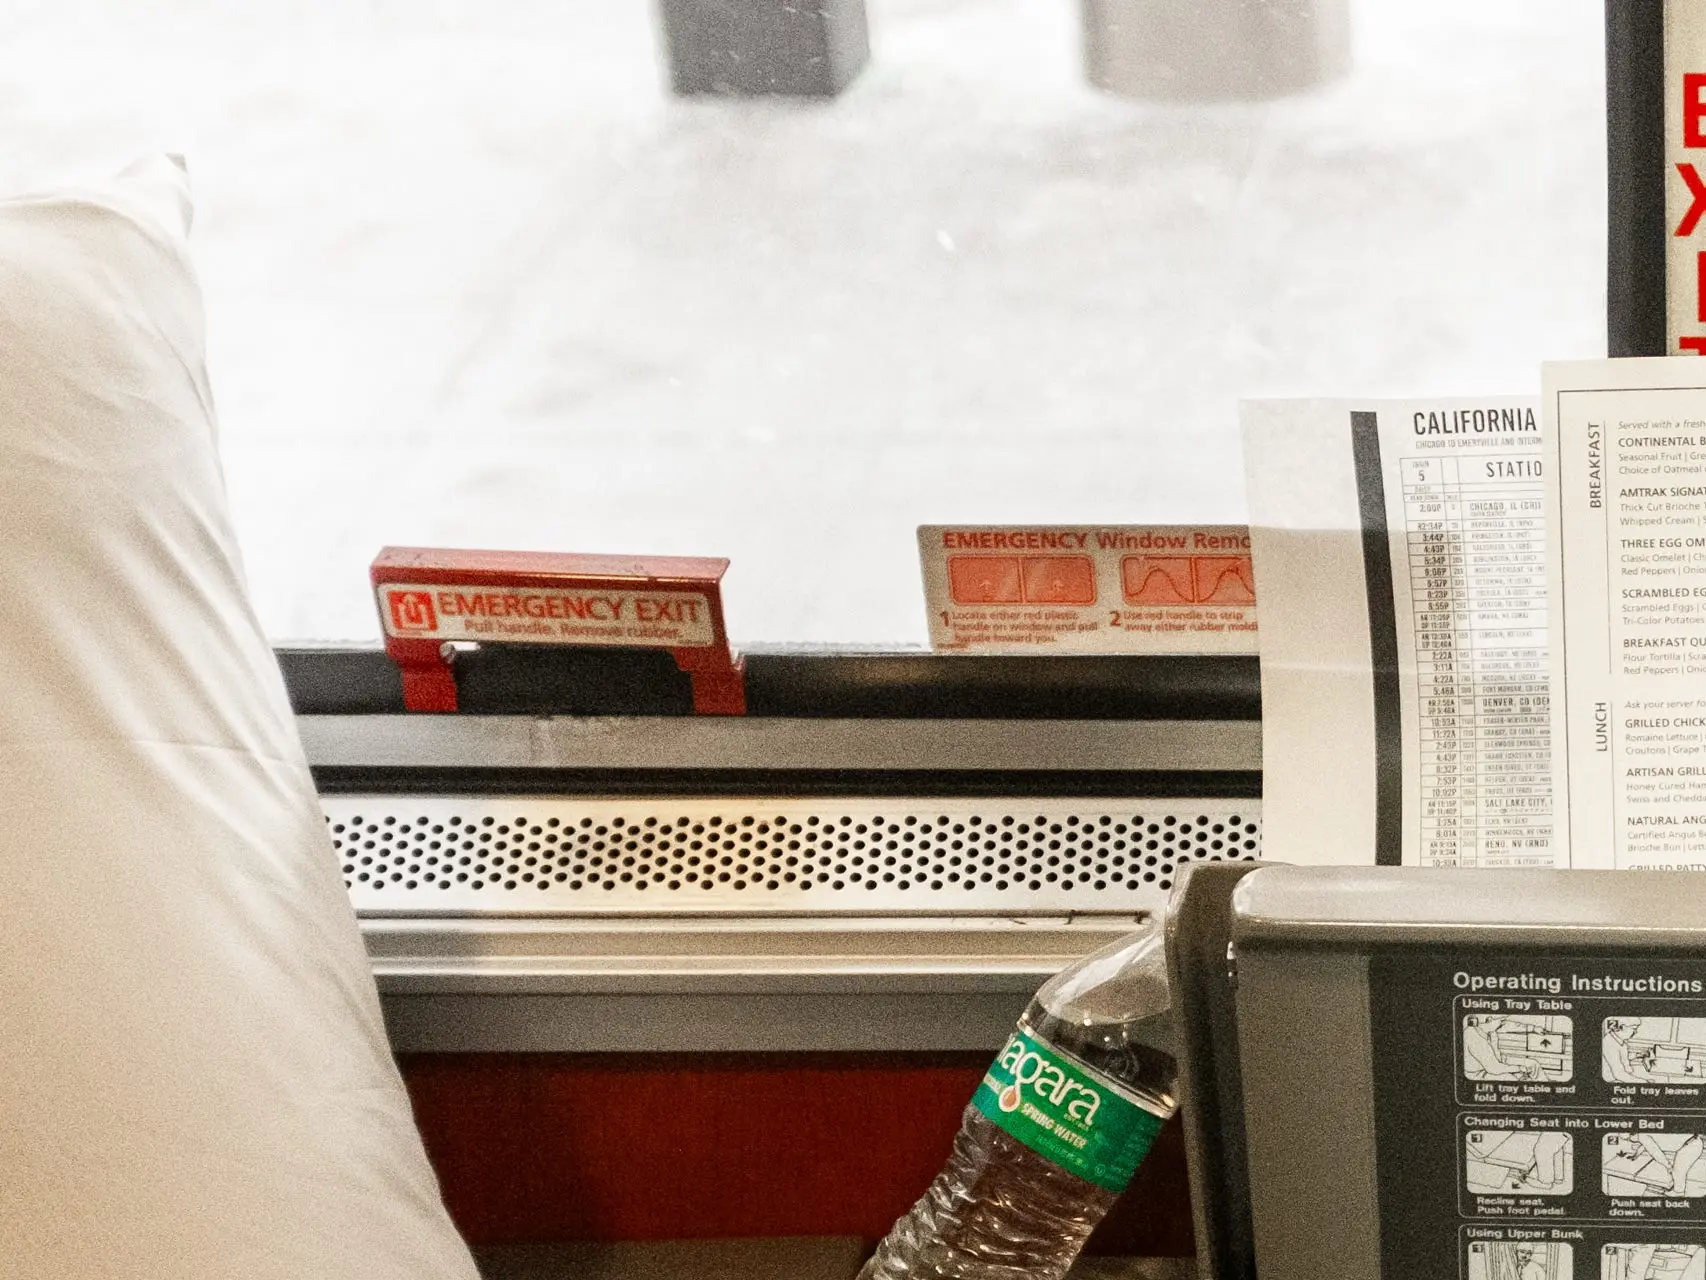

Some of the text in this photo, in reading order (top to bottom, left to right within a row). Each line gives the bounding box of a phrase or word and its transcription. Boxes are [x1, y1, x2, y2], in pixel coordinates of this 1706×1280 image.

[1414, 408, 1537, 435] CALIFORNIA
[1618, 436, 1695, 447] CONTINENTAL
[1588, 422, 1601, 508] BREAKFAST
[1418, 470, 1424, 482] 5
[1619, 487, 1666, 497] AMTRAK
[943, 532, 1087, 548] EMERGENCY
[1097, 532, 1186, 549] Window
[1621, 539, 1654, 548] THREE
[1659, 538, 1682, 547] EGG
[1622, 588, 1689, 598] SCRAMBLED
[438, 592, 700, 622] EMERGENCY EXIT
[940, 611, 949, 626] 1
[1110, 611, 1122, 626] 2
[1623, 637, 1685, 647] BREAKFAST
[1596, 702, 1608, 752] LUNCH
[1624, 718, 1670, 728] GRILLED
[1626, 767, 1674, 776] ARTISAN
[1627, 815, 1677, 825] NATURAL
[1453, 972, 1702, 993] Operating Instructions
[1462, 999, 1572, 1010] Using Tray Table
[1475, 1084, 1576, 1095] Lift tray table and
[1613, 1086, 1699, 1097] Fold tray leaves
[1474, 1094, 1535, 1102] fold down.
[1021, 1102, 1054, 1130] SPRING
[1055, 1125, 1087, 1149] WATER
[1464, 1117, 1664, 1129] Changing Seat into Lower Bed
[1611, 1200, 1690, 1208] Push seat back
[1608, 1208, 1644, 1216] down.
[1466, 1229, 1583, 1240] Using Upper Bunk
